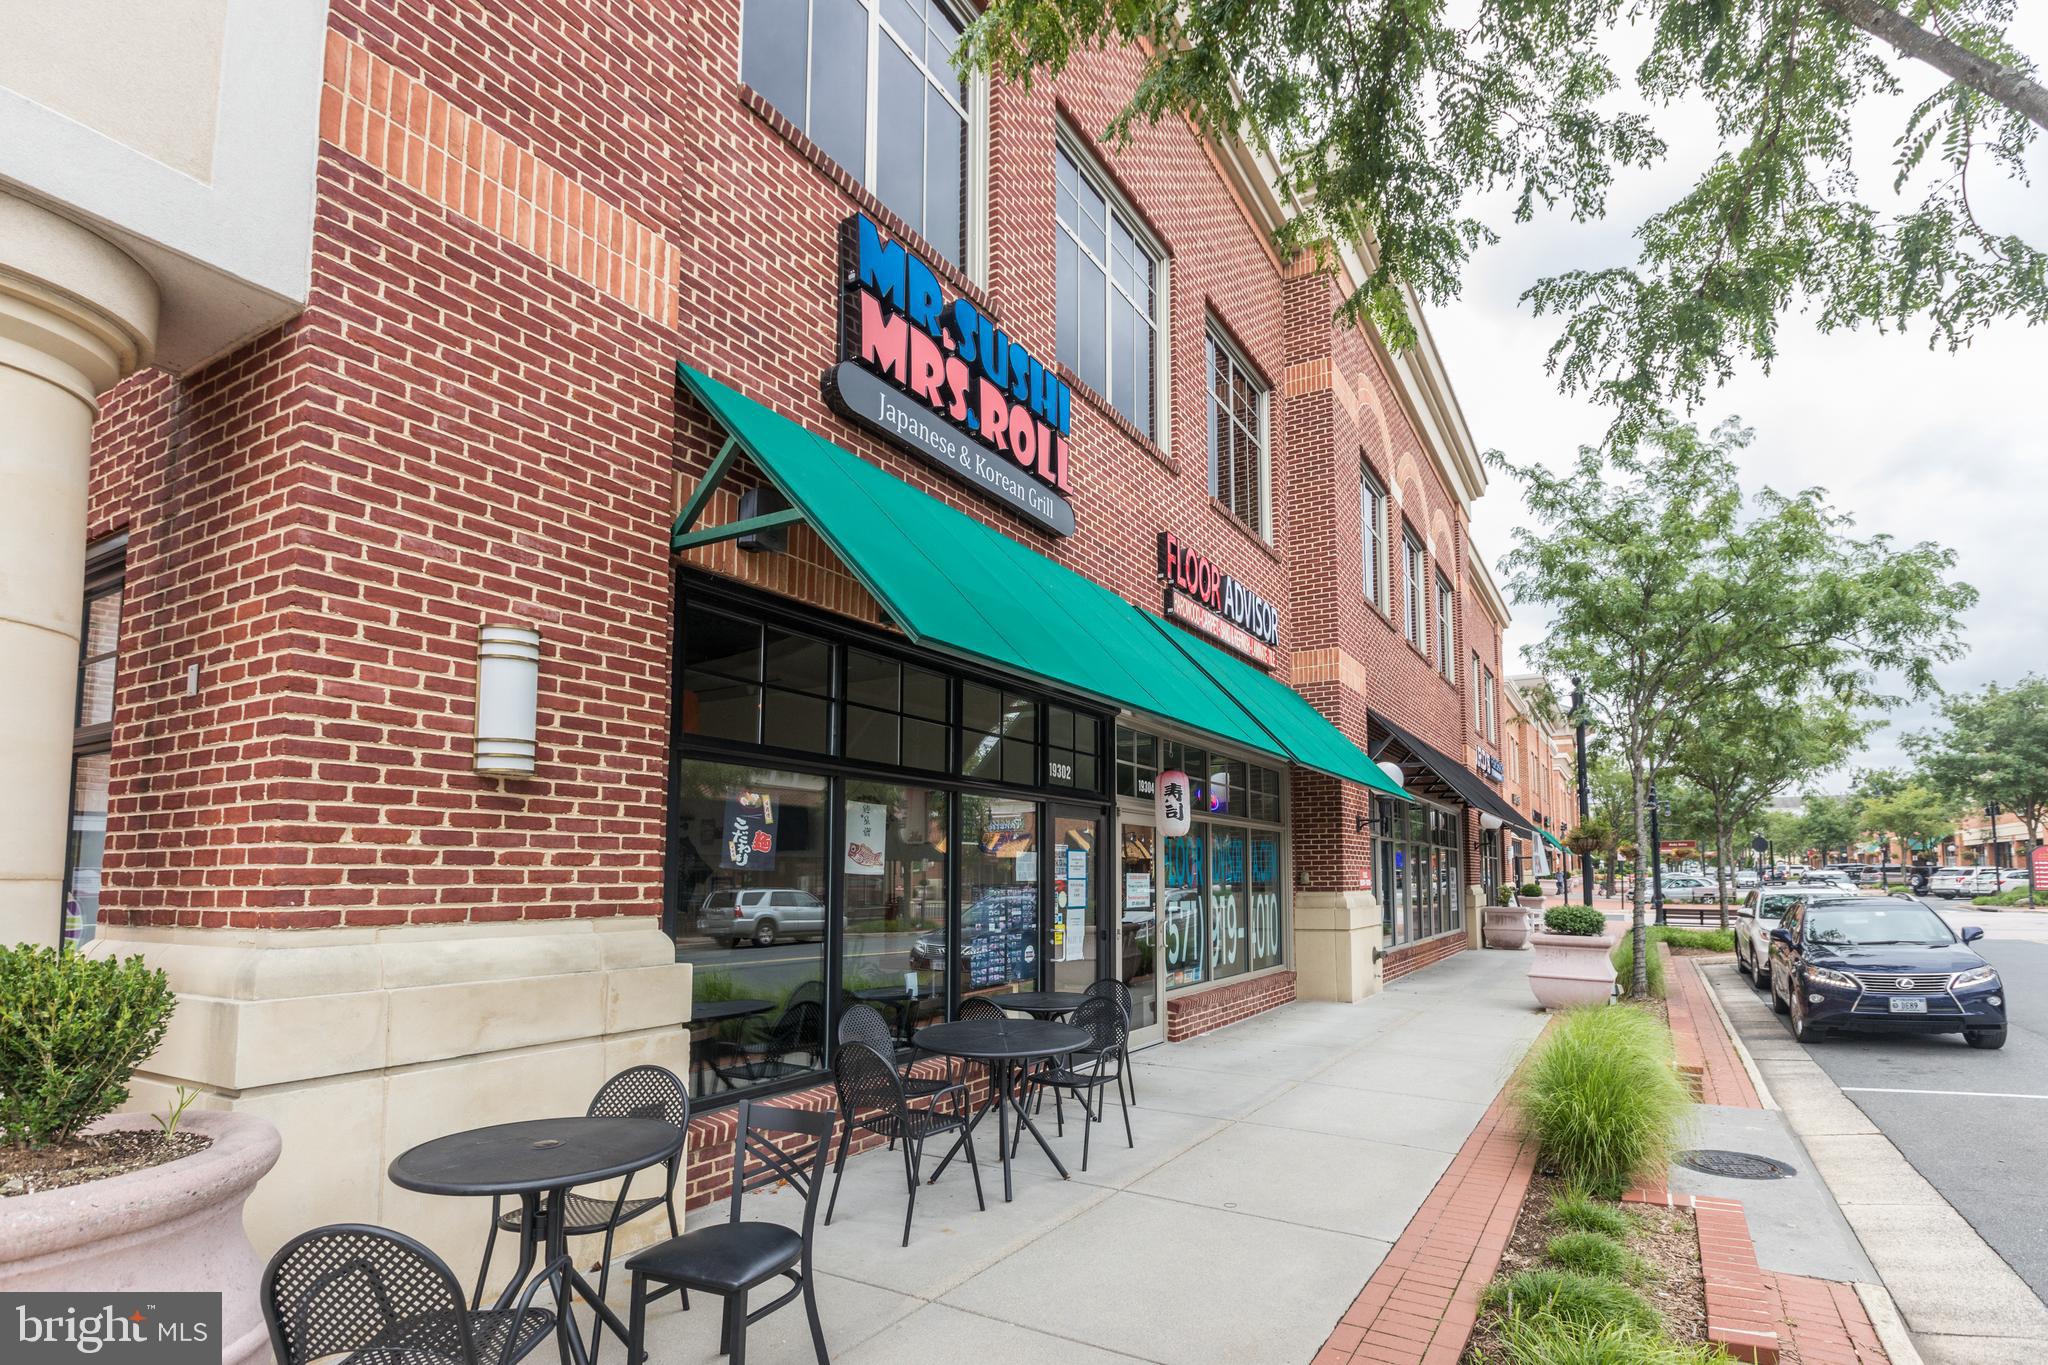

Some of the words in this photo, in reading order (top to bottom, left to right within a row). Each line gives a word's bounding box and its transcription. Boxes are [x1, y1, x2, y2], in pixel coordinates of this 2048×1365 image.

[955, 298, 1071, 437] SUSHI
[878, 393, 956, 461] Japanese
[959, 446, 972, 467] &
[975, 452, 1025, 502] Korean
[1028, 487, 1054, 519] Grill
[979, 376, 1073, 495] ROLL
[1166, 532, 1222, 611] FLOOR
[1224, 576, 1280, 647] ADVISOR
[1049, 762, 1072, 780] 19302
[1138, 779, 1155, 795] 19304
